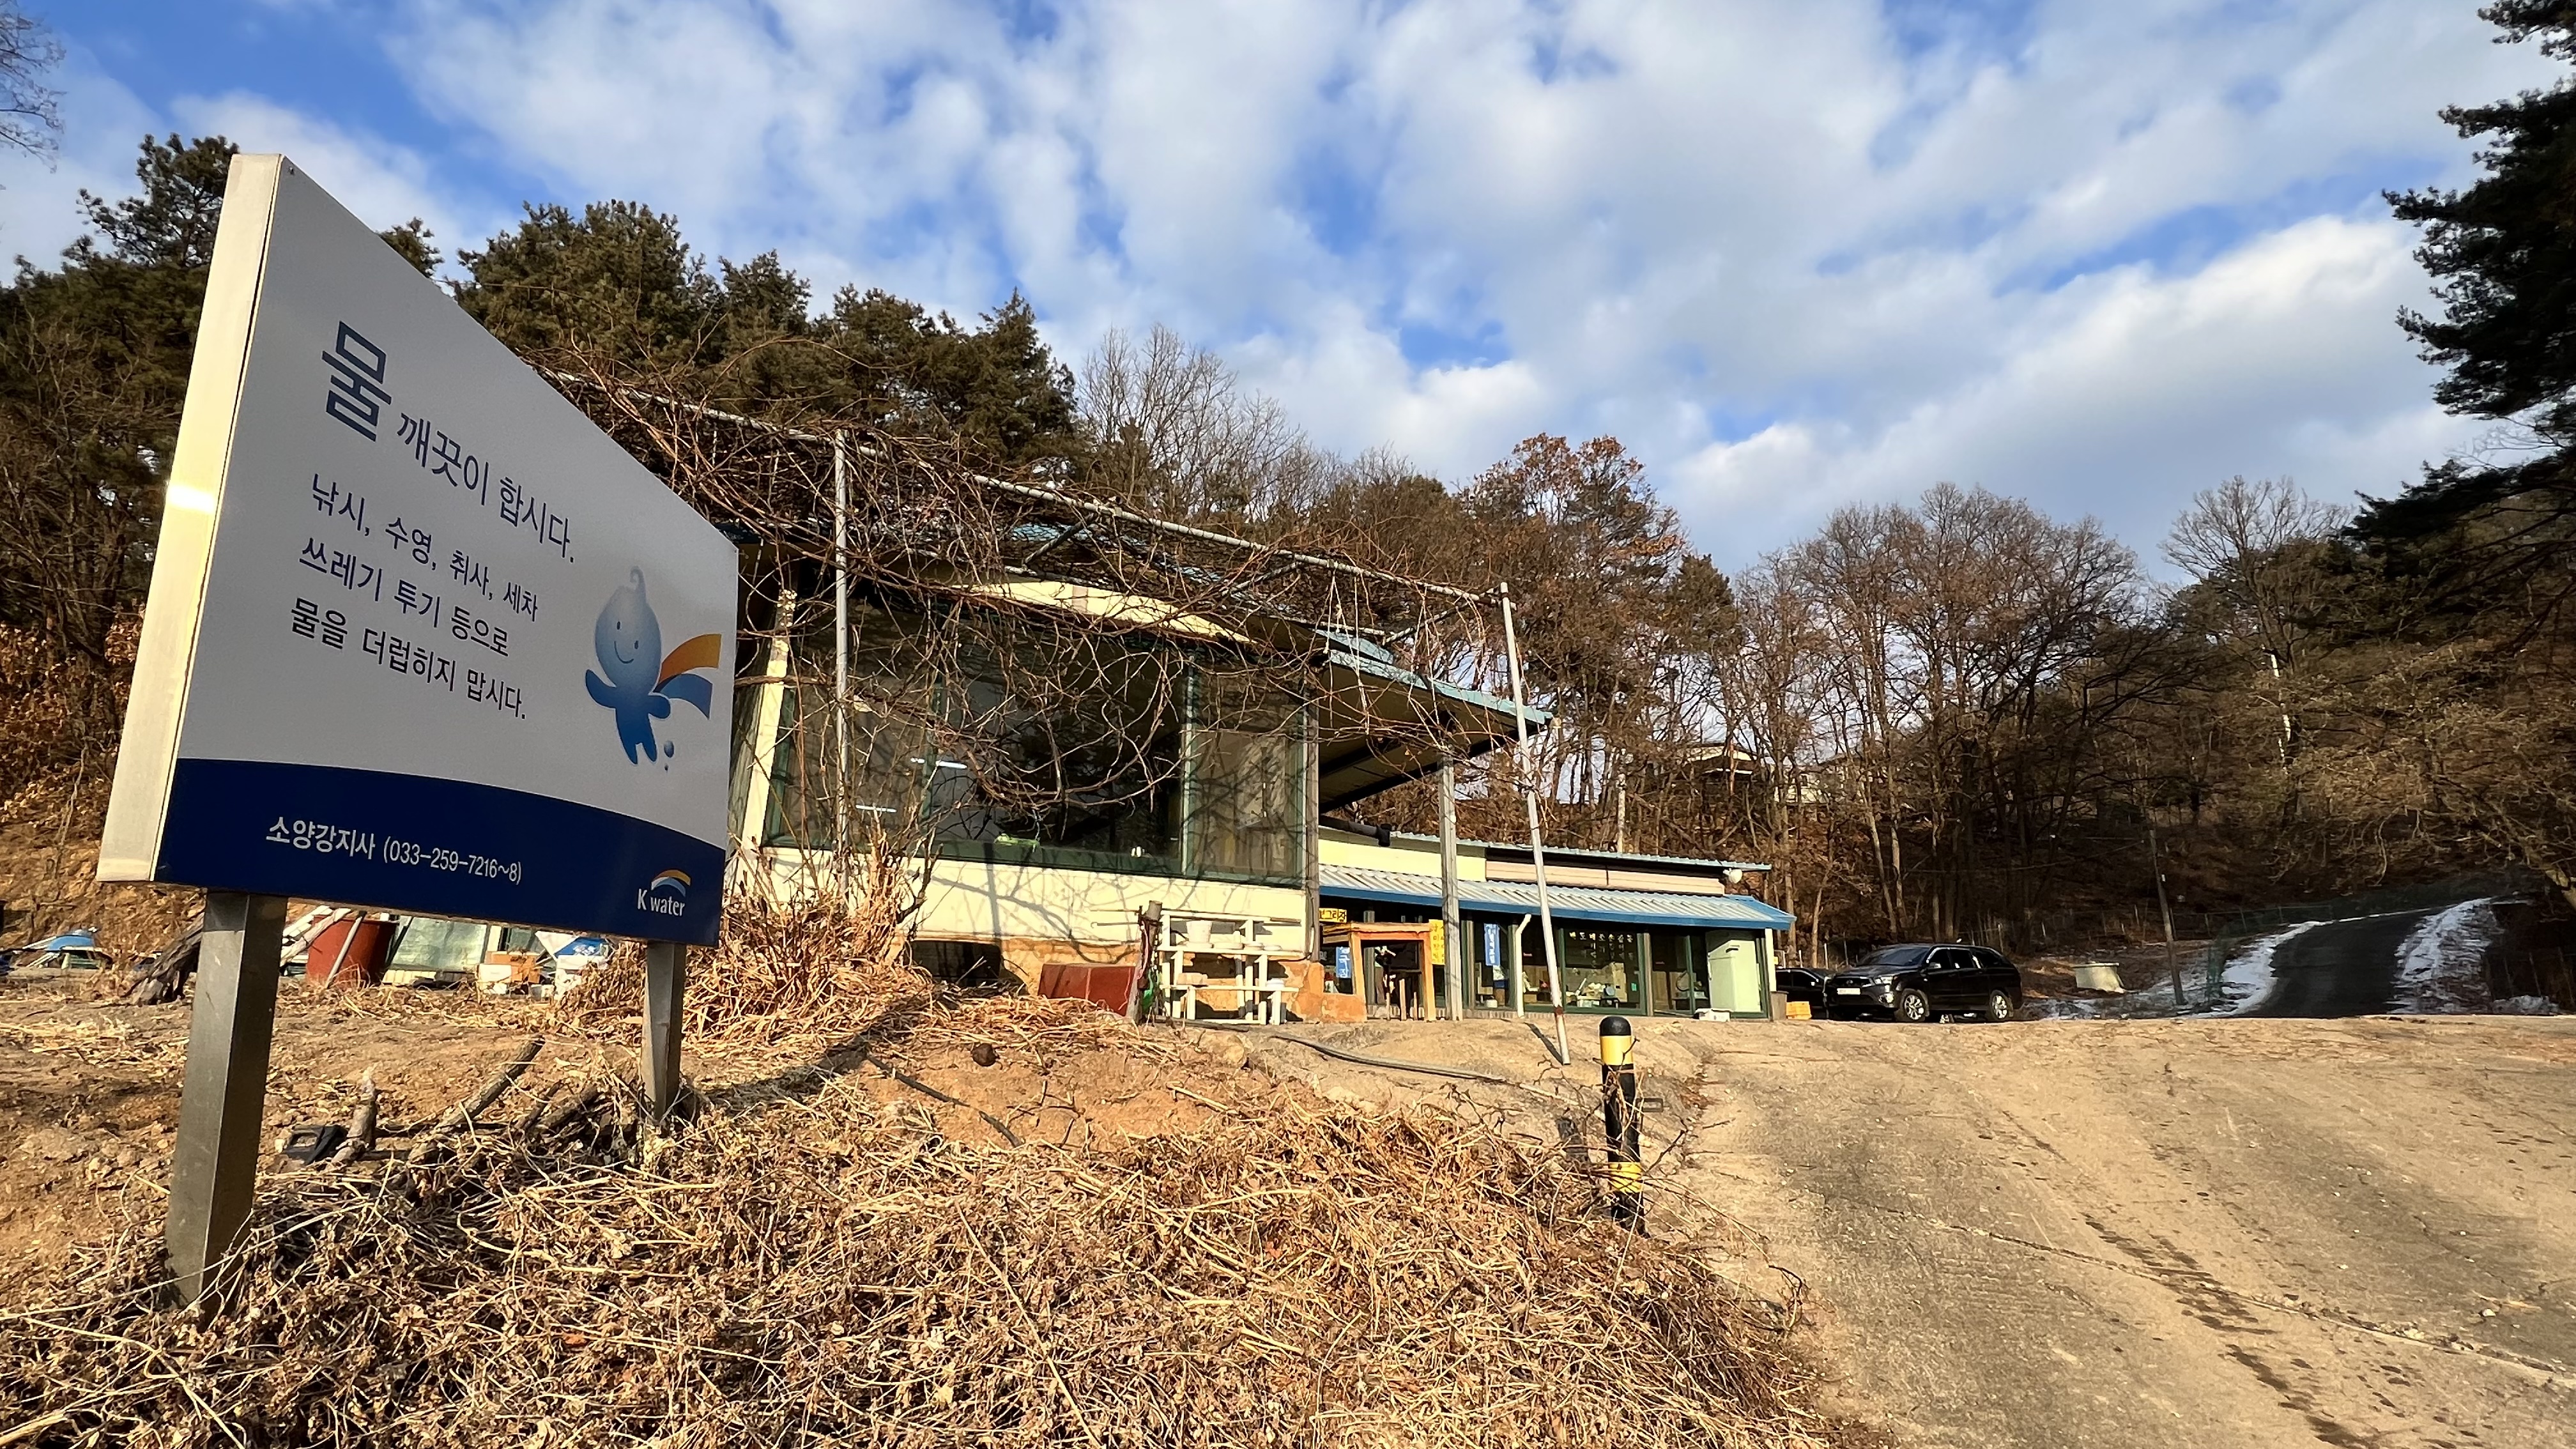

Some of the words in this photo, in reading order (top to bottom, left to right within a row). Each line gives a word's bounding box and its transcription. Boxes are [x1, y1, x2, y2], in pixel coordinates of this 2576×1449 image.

[321, 320, 392, 442] 물
[396, 412, 489, 507] 깨끗이
[500, 477, 574, 564] 합시다.
[299, 536, 383, 602] 쓰레기
[394, 579, 441, 628] 투기
[450, 606, 509, 657] 등으로
[312, 473, 371, 537] 낚시,
[385, 517, 436, 571] 수영,
[449, 549, 493, 601] 취사,
[502, 581, 538, 622] 세차
[290, 597, 348, 650] 물을
[362, 628, 456, 692] 더럽히지
[467, 669, 526, 719] 맙시다.
[266, 816, 376, 860] 소양강지사
[383, 836, 521, 885] (033-259-7216~8)
[637, 888, 648, 910] K
[650, 896, 686, 916] water
